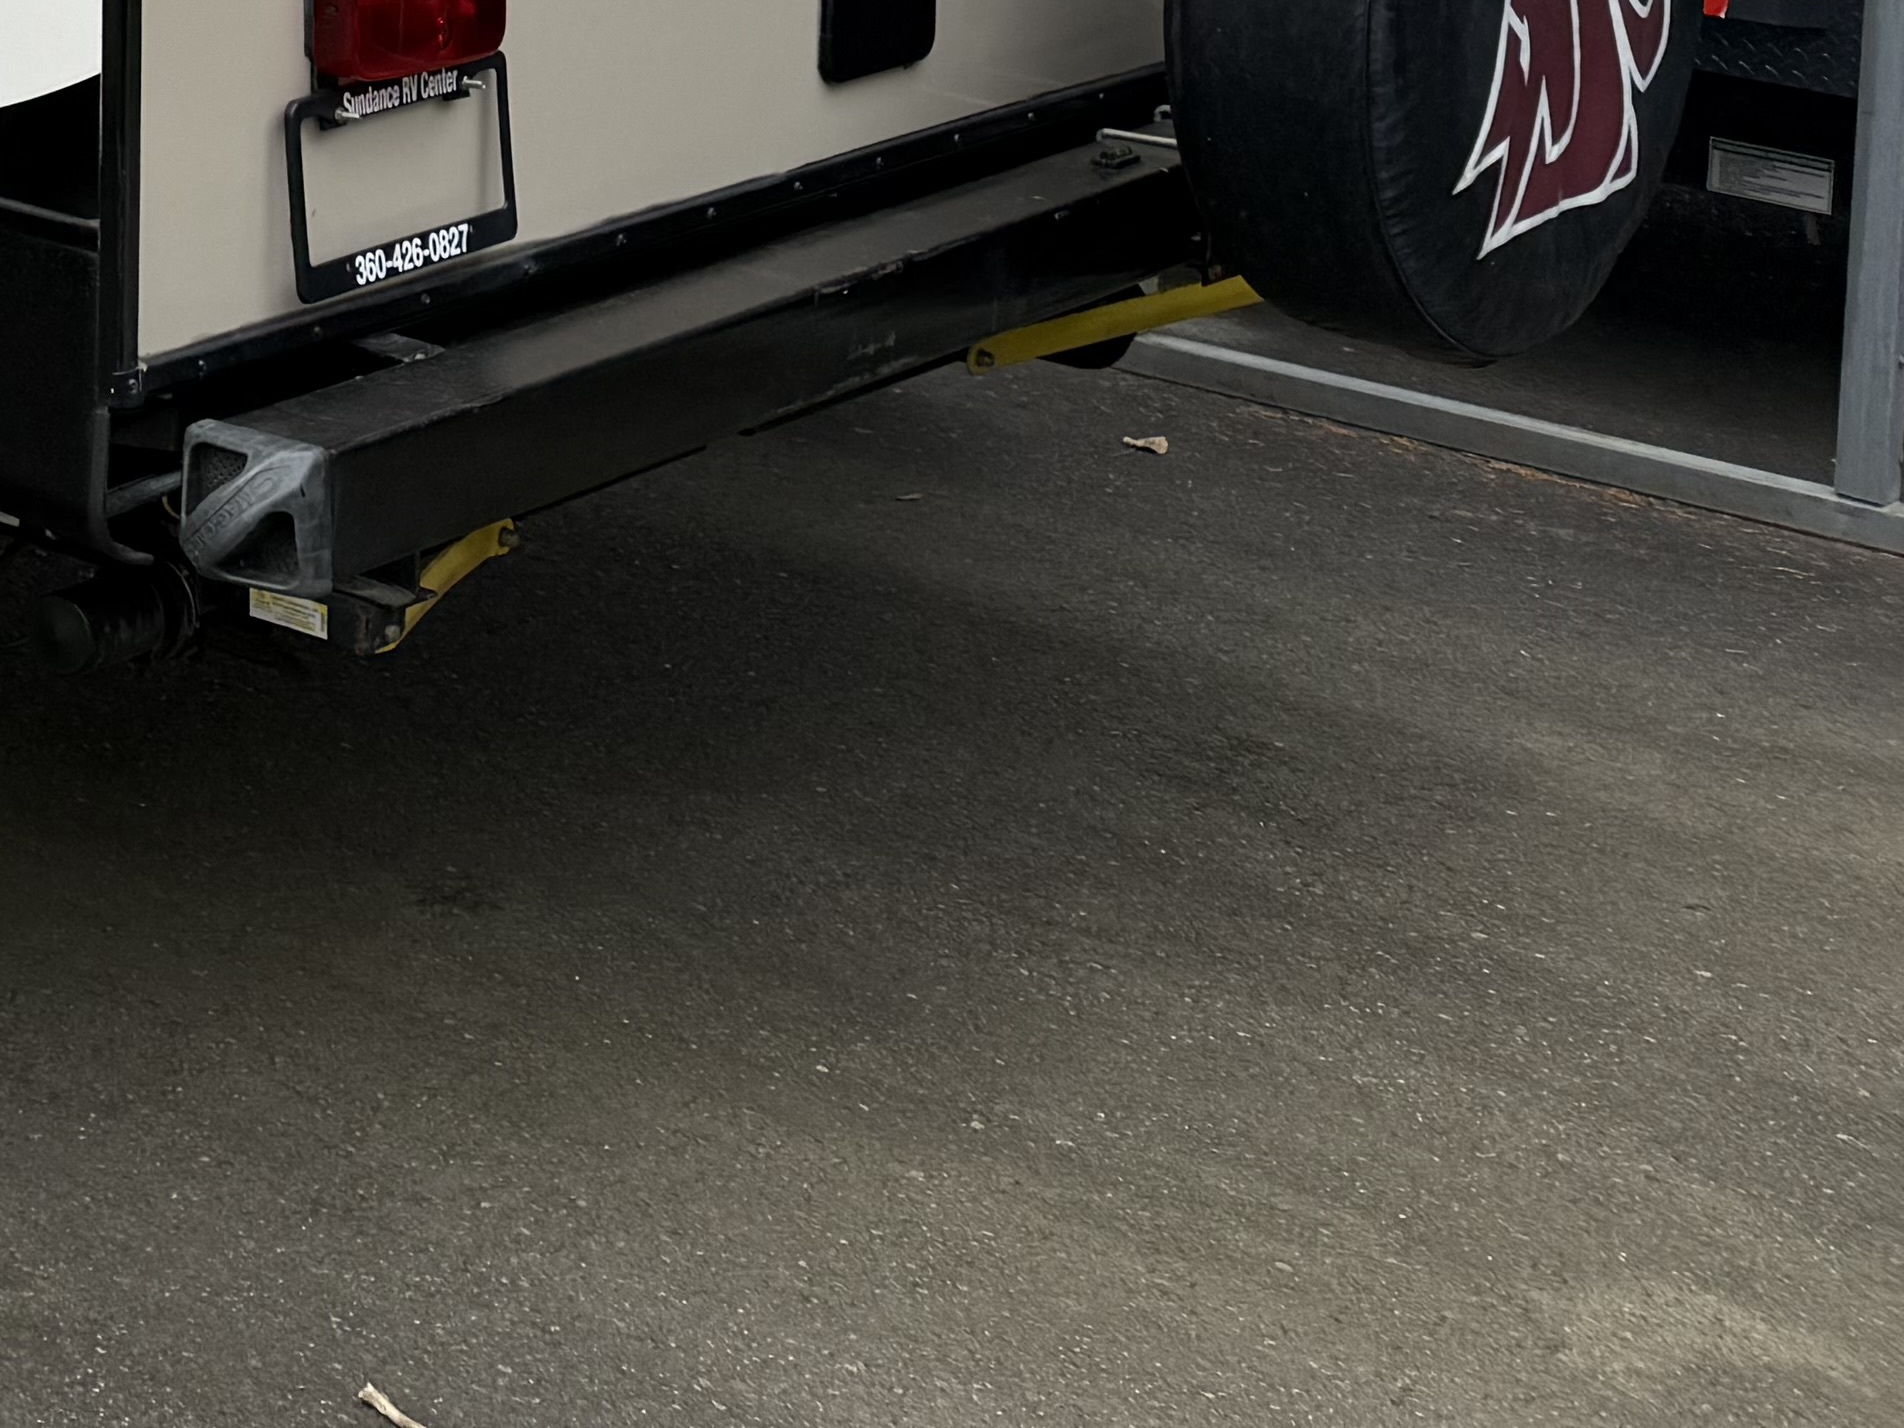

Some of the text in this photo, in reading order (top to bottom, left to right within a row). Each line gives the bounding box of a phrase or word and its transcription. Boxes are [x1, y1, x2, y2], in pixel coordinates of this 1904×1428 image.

[343, 68, 459, 115] Sundance RV Center
[355, 223, 469, 285] 360-426-0827
